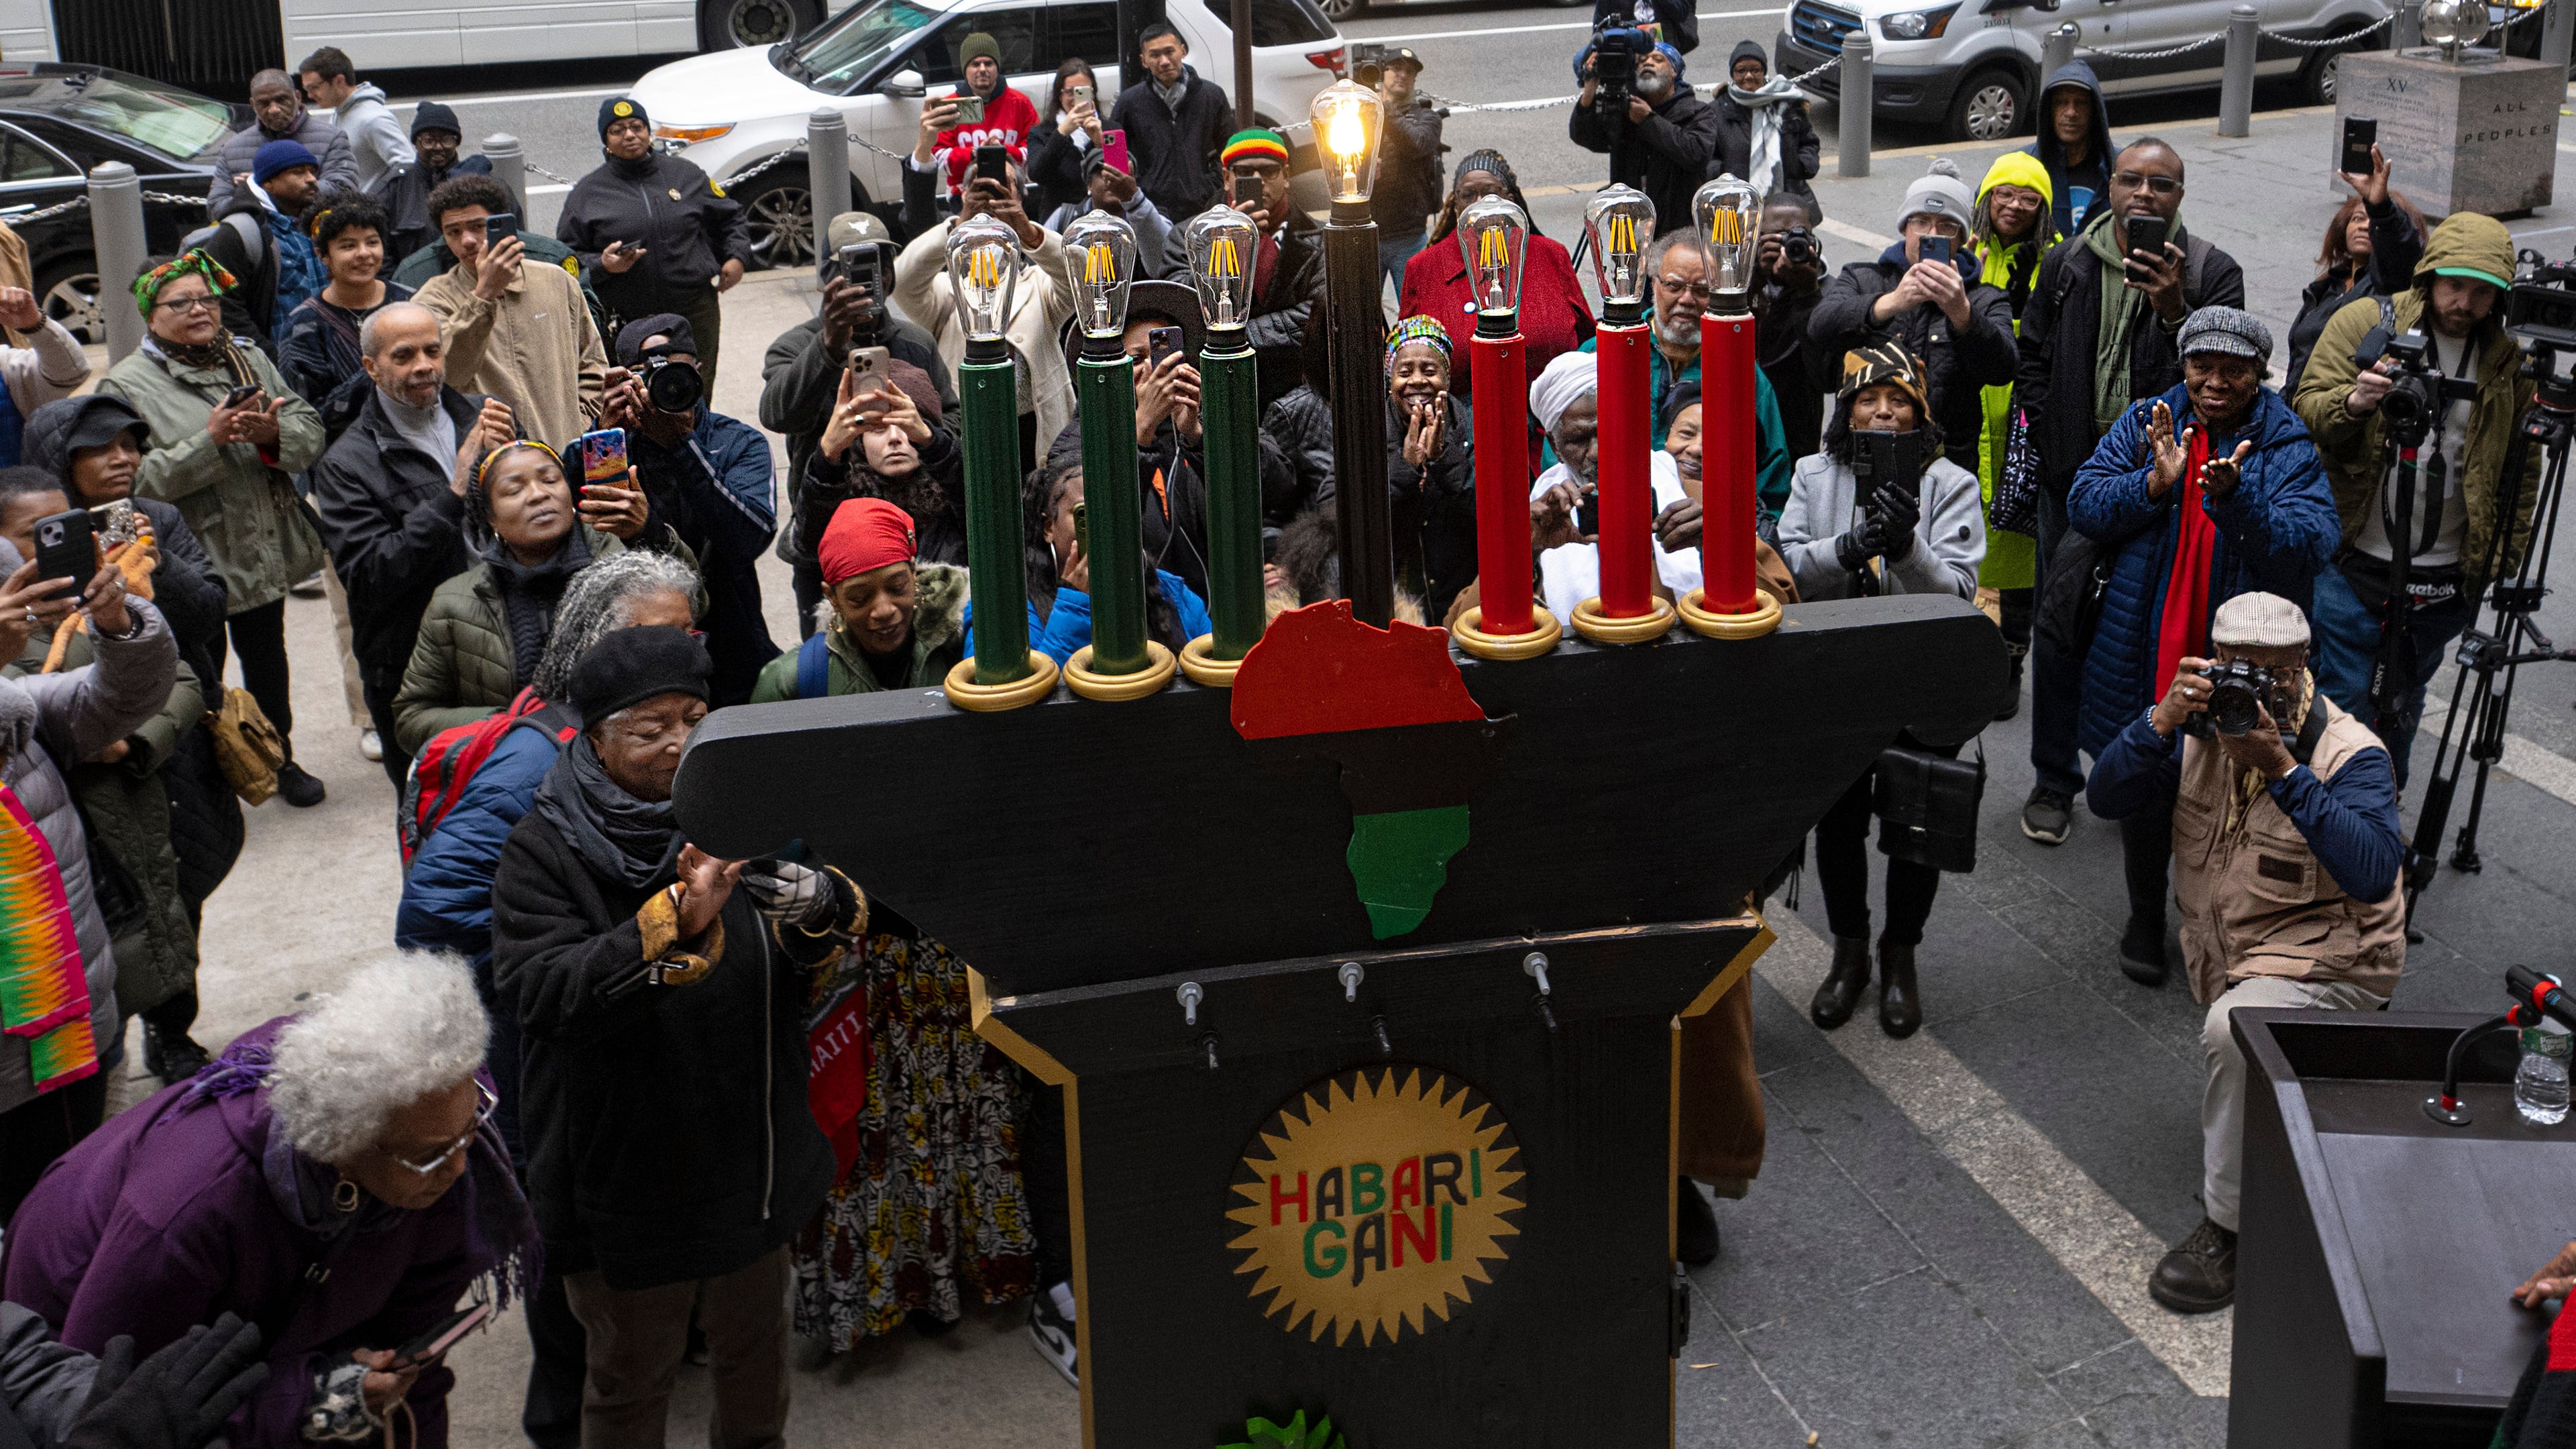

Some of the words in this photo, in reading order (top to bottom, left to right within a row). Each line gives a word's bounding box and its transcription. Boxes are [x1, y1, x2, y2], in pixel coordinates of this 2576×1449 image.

[2387, 78, 2408, 93] XV
[2492, 101, 2527, 114] ALL
[2464, 124, 2551, 144] PEOPLES
[1271, 1148, 1482, 1226] HABARI
[1303, 1202, 1453, 1288] GANI
